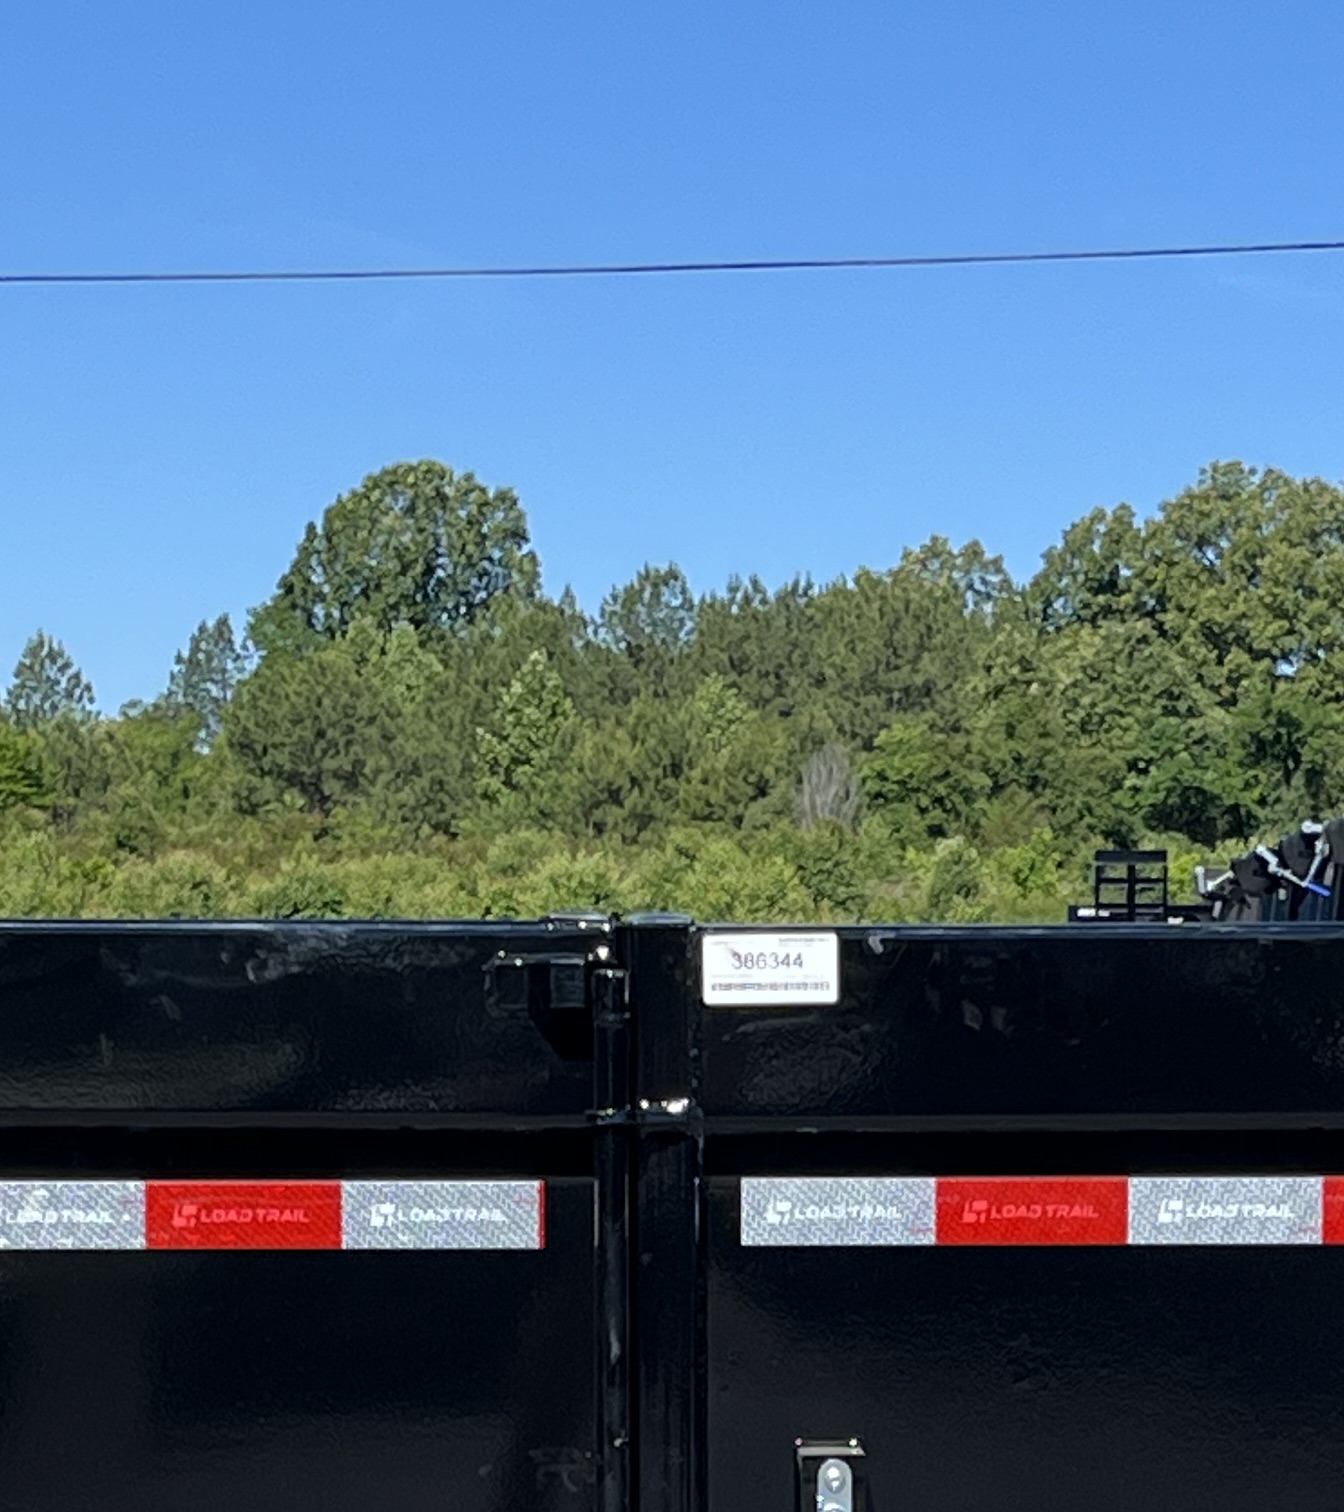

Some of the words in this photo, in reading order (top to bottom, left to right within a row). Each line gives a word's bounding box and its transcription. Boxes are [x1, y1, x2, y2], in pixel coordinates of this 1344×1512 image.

[199, 1207, 254, 1223] LOAD
[256, 1207, 310, 1224] TRAIL
[989, 1204, 1043, 1220] LOAD
[1045, 1204, 1100, 1218] TRAIL
